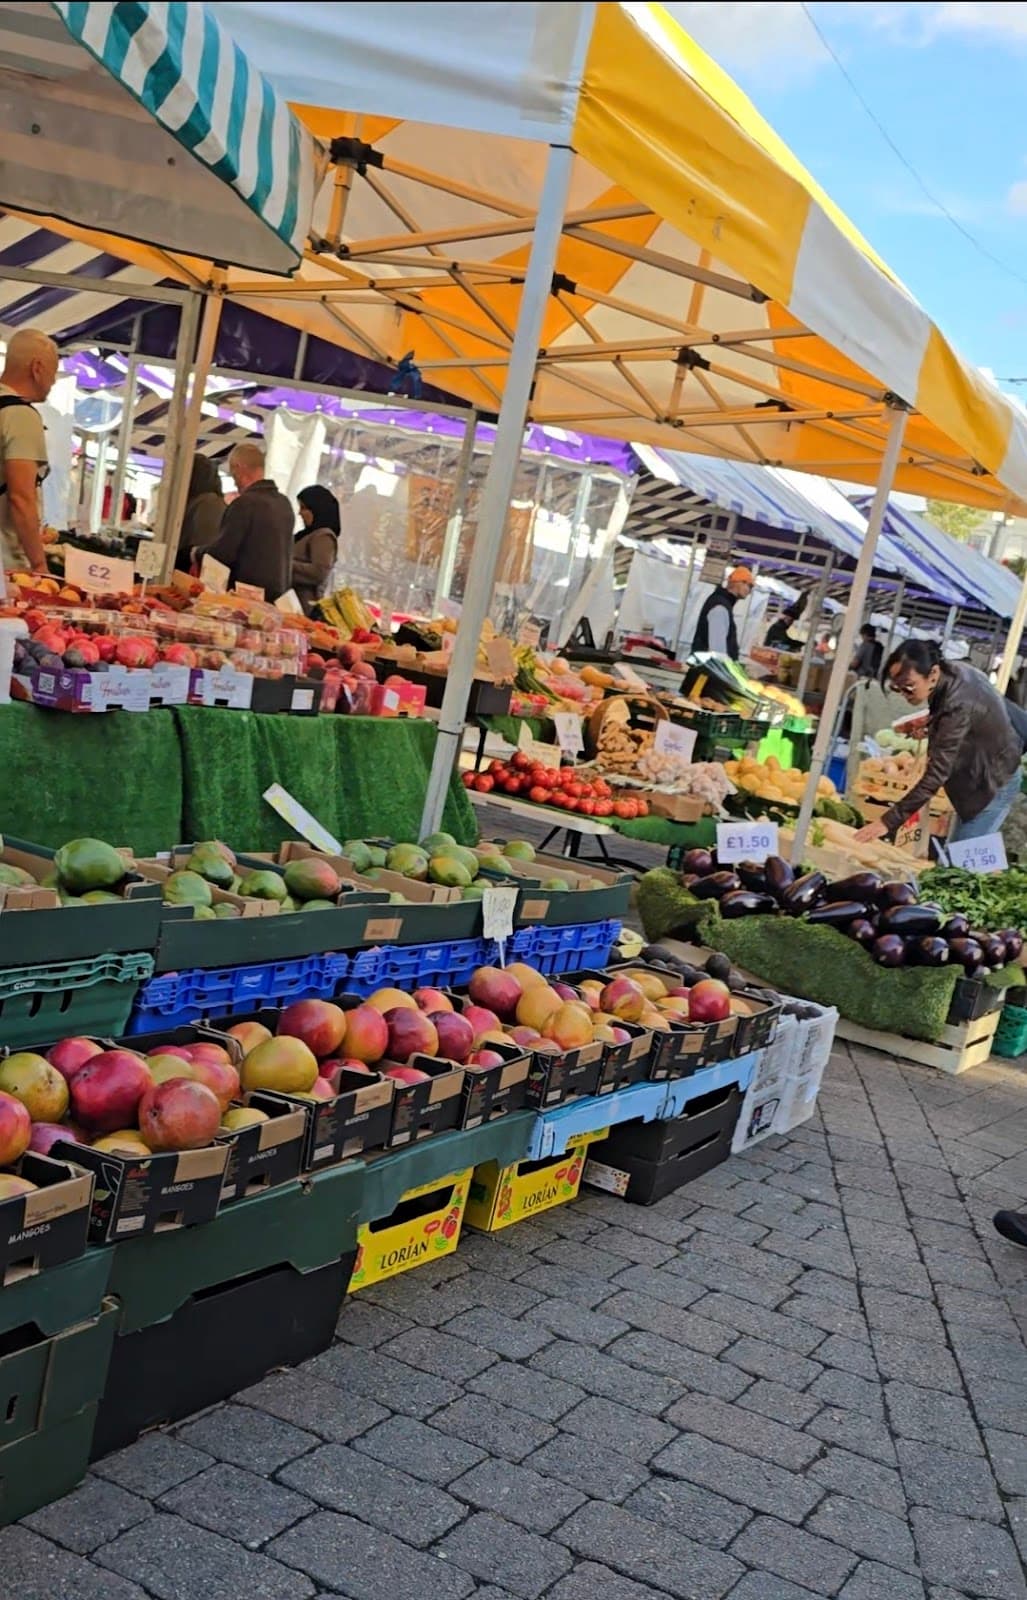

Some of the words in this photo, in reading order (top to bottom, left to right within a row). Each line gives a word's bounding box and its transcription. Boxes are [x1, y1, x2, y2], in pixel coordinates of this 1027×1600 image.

[88, 564, 111, 580] £2
[726, 835, 770, 849] £1.50
[962, 853, 997, 868] £150
[161, 1182, 195, 1195] MANGOES
[8, 1223, 51, 1245] MANGOES
